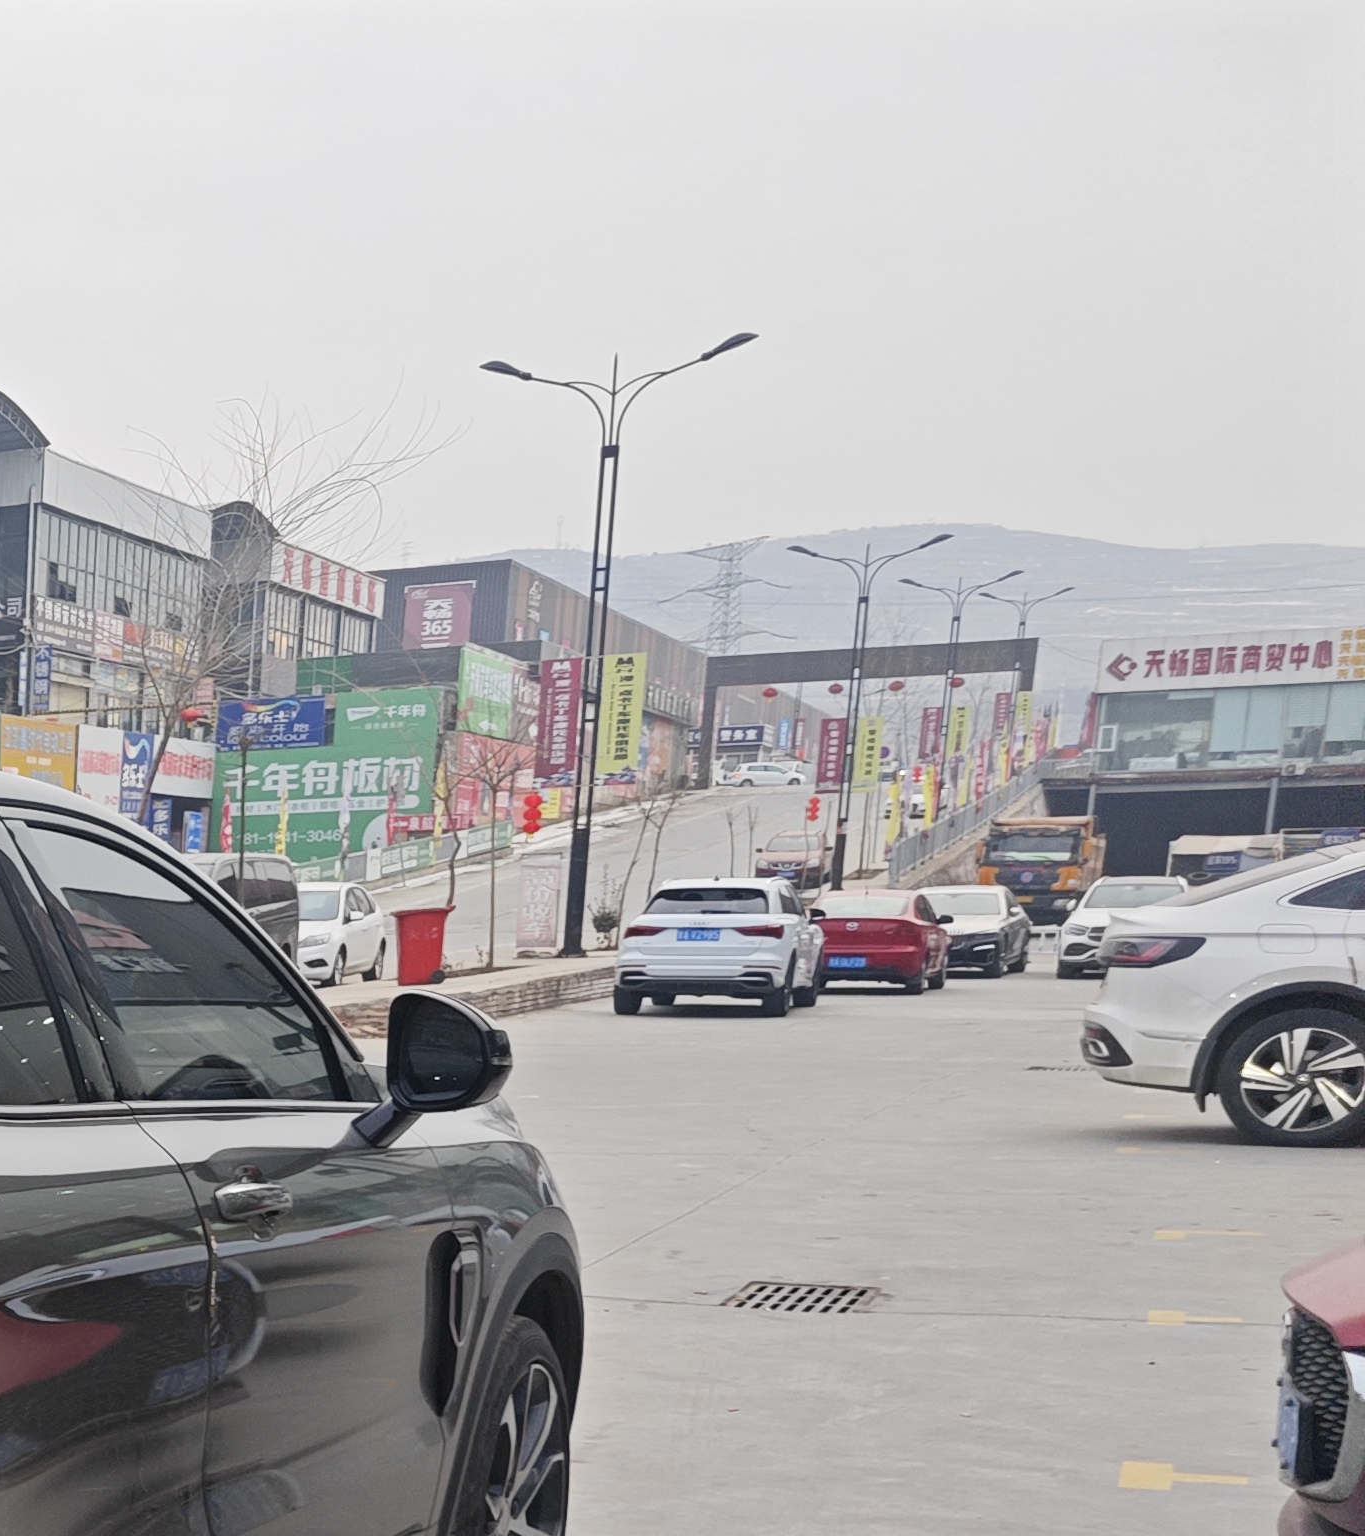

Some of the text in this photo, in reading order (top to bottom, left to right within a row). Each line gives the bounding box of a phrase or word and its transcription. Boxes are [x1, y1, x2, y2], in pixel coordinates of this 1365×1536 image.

[421, 620, 453, 636] 365
[1144, 639, 1333, 679] 天畅国际商贸中心
[383, 704, 426, 718] 千年舟
[223, 757, 423, 799] 千年舟板材
